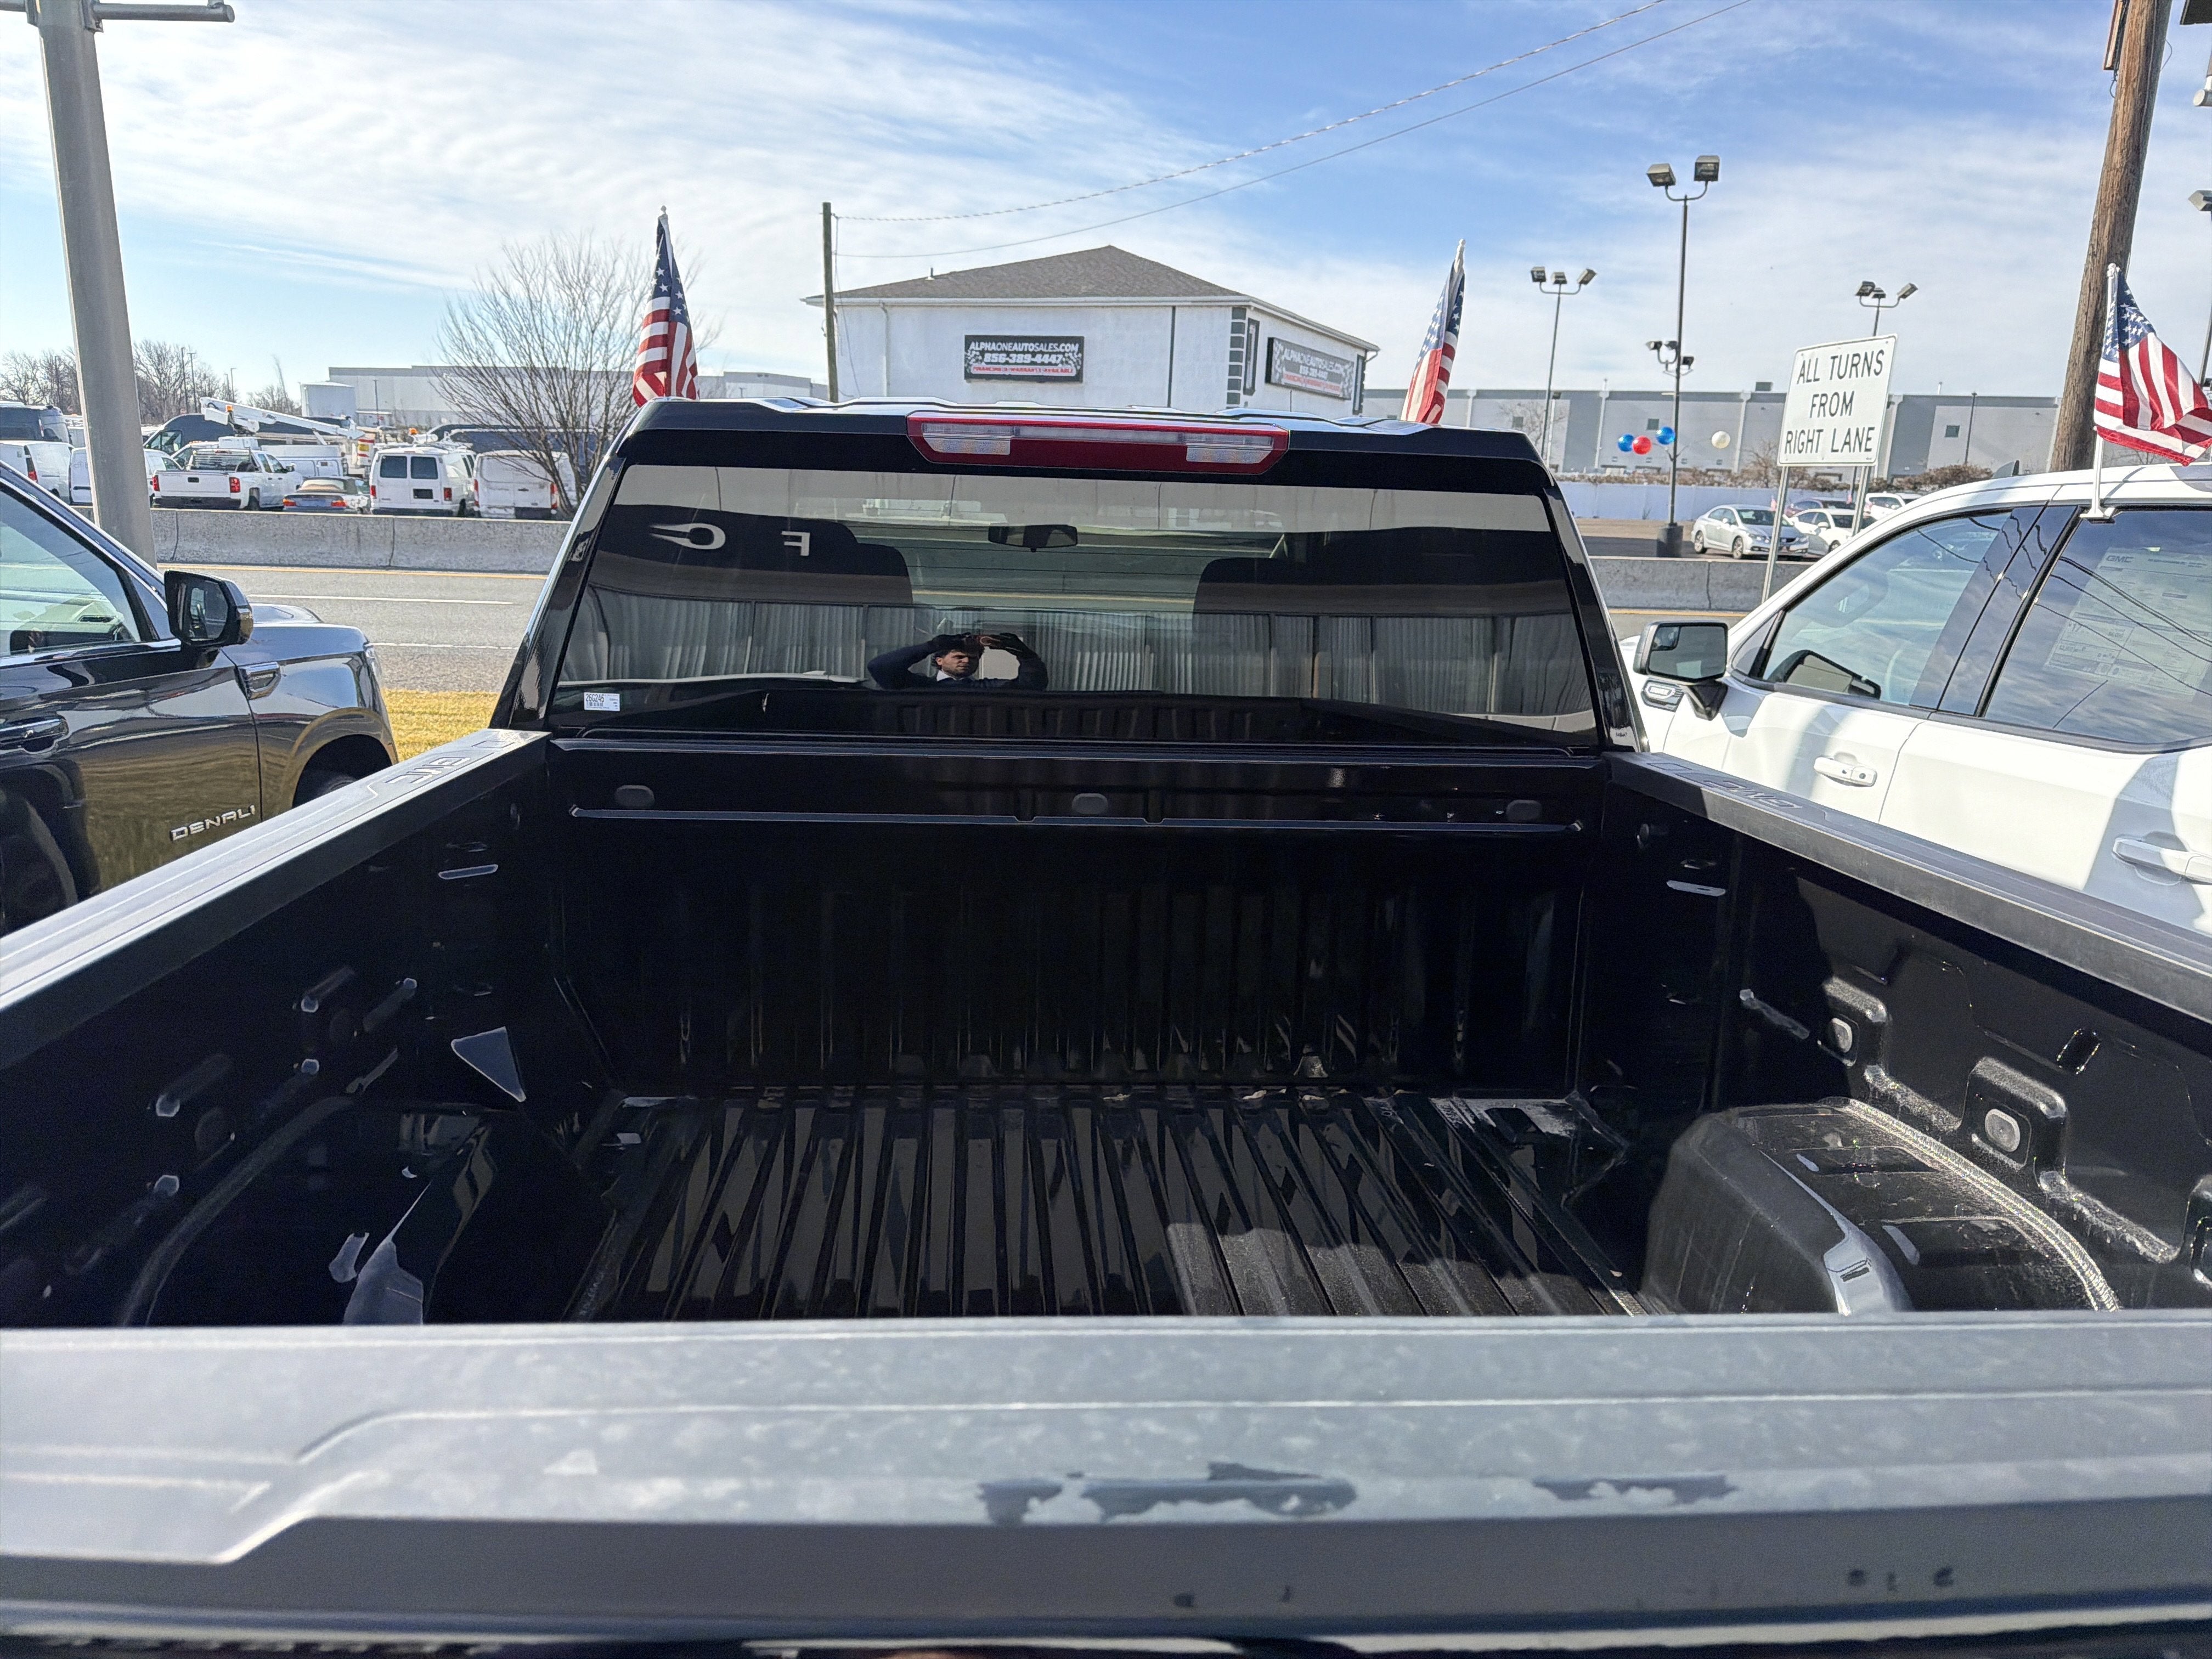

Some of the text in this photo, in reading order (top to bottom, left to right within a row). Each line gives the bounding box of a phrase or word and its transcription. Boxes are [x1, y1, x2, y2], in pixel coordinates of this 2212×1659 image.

[969, 342, 1079, 352] ALPHAONEAUTOSALES.COM
[1796, 349, 1884, 385] ALL TURNS
[1809, 390, 1855, 419] FROM
[1784, 426, 1875, 454] RIGHT LANE
[170, 804, 256, 841] DENALI
